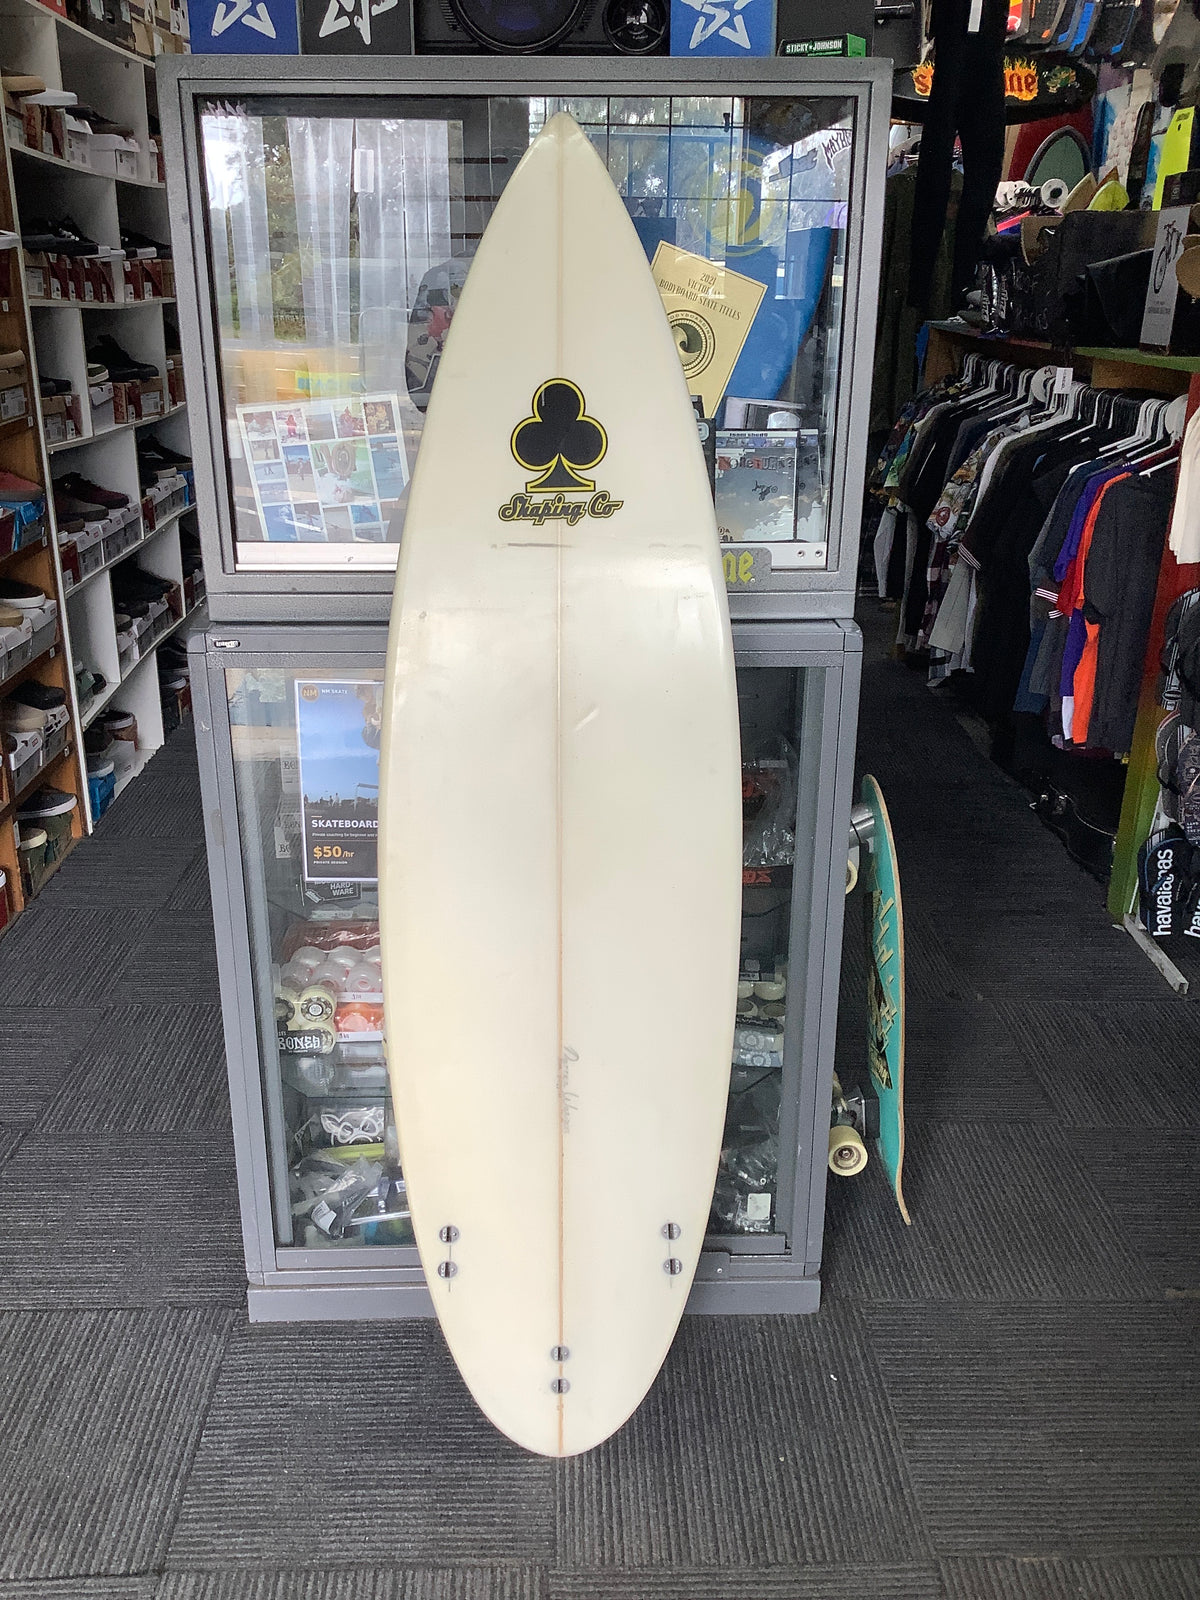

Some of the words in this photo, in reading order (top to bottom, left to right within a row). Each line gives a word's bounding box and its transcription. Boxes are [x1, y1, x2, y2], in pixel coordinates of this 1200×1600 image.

[786, 43, 809, 53] STICKY
[812, 39, 842, 51] JOHNSON
[659, 278, 698, 302] BODYBOARD
[698, 297, 718, 311] STATE
[719, 304, 741, 321] TITLES
[668, 311, 713, 343] ODYBOARDING
[498, 492, 587, 526] Shaping
[588, 490, 624, 518] Co
[303, 689, 318, 697] NM
[332, 888, 354, 896] WARE
